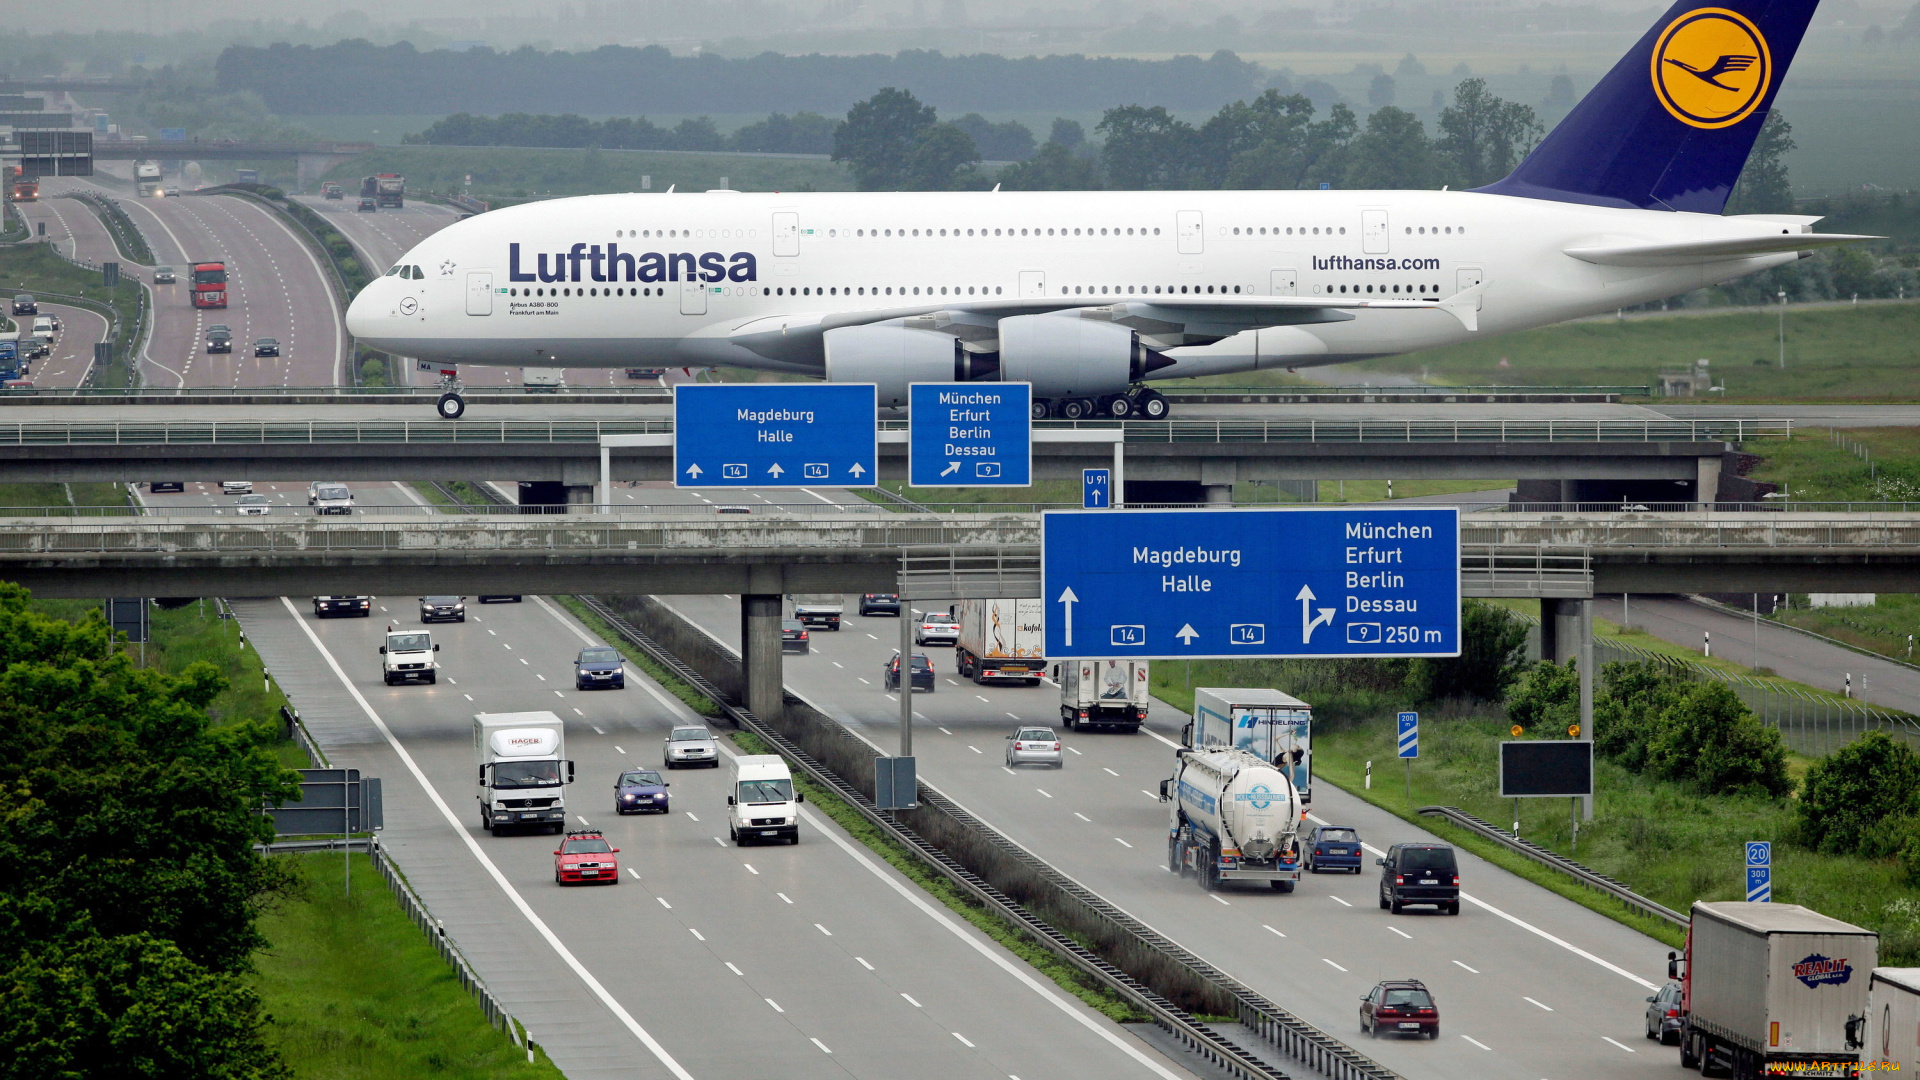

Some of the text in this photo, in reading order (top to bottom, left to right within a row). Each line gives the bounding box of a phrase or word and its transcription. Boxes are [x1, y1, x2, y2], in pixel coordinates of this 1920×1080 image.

[509, 242, 757, 283] Lufthansa
[1312, 255, 1440, 270] lufthansa.com
[939, 392, 1001, 404] München
[737, 408, 814, 424] Magdeburg
[950, 409, 990, 422] Erfurt
[757, 430, 794, 442] Halle
[949, 426, 991, 439] Berlin
[945, 443, 996, 456] Dessau
[729, 466, 741, 476] 14
[811, 466, 822, 475] 14
[985, 466, 992, 475] 9
[1086, 475, 1106, 485] U 91
[1345, 522, 1433, 539] München
[1133, 546, 1241, 567] Magdeburg
[1346, 546, 1402, 564] Erfurt
[1162, 575, 1212, 592] Halle
[1346, 571, 1404, 588] Berlin
[1346, 596, 1417, 613] Dessau
[1120, 629, 1135, 642] 14
[1240, 628, 1255, 641] 14
[1360, 626, 1442, 643] 9 250 m
[1750, 848, 1766, 860] 20
[1751, 870, 1766, 878] 300
[1794, 958, 1847, 977] REALIT
[1807, 972, 1832, 982] GLOBAL
